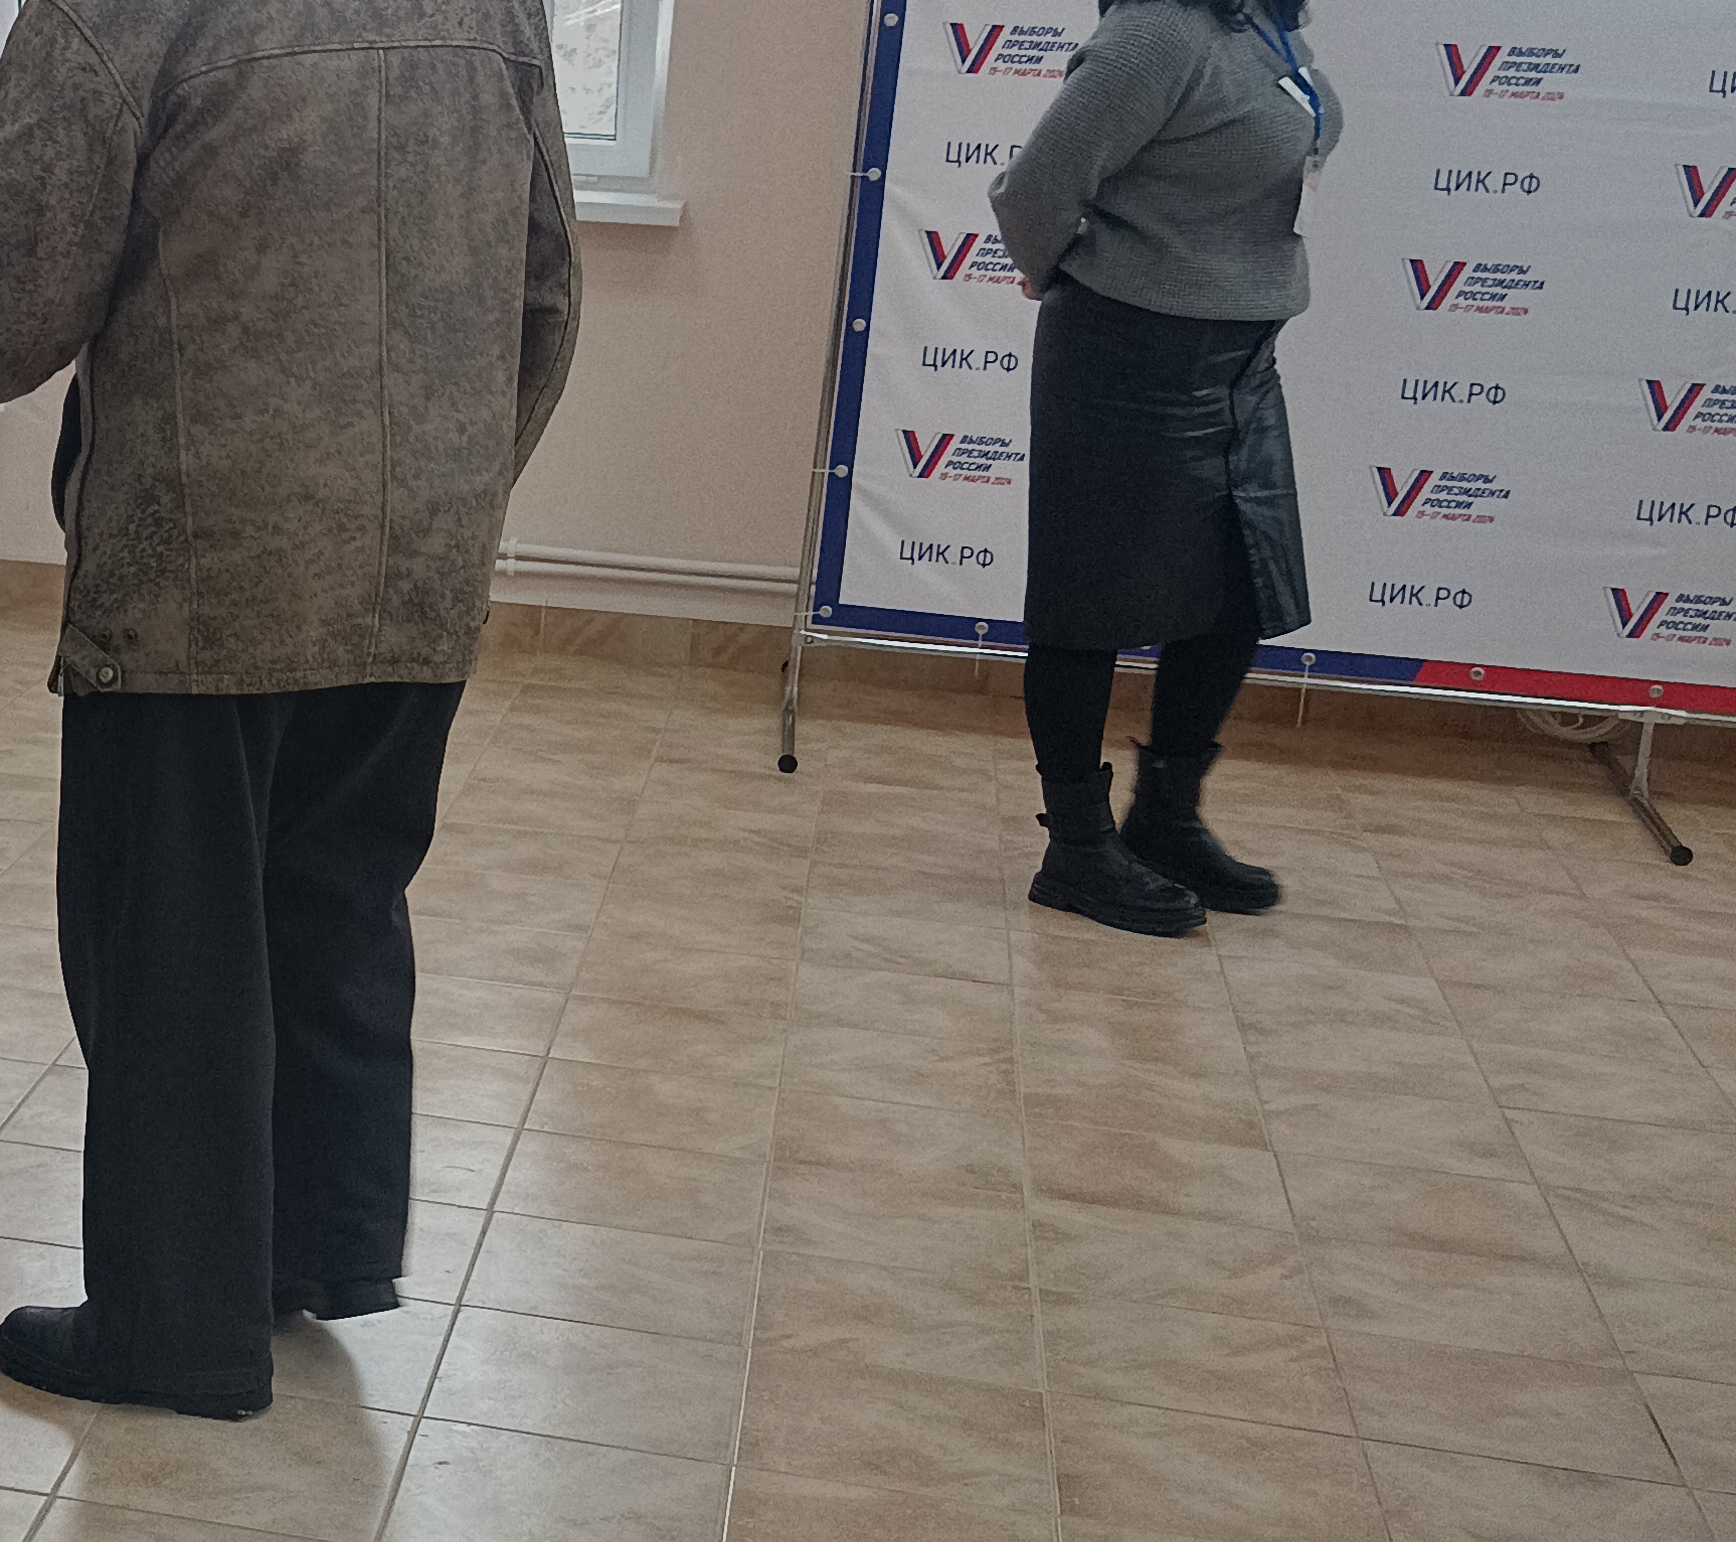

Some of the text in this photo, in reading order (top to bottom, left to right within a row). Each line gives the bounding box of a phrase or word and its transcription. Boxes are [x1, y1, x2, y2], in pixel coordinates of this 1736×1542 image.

[1010, 26, 1065, 37] ВЫБОРЫ
[994, 54, 1044, 64] РОССИИ
[1507, 47, 1566, 58] ВЫБОРЫ
[1497, 61, 1580, 74] ПРЕЗИДЕНТА
[1490, 75, 1543, 87] РОССИИ
[945, 141, 1023, 168] ЦИК.
[1434, 168, 1540, 196] ЦИК.РФ
[1472, 263, 1531, 275] ВЫБОРЫ
[1464, 277, 1545, 290] ПРЕЗИДЕНТА
[1455, 290, 1508, 302] РОССИИ
[921, 346, 1019, 373] ЦИК.РФ
[1401, 378, 1506, 405] ЦИК.РФ
[959, 435, 1012, 448] ВЫБОРЫ
[952, 448, 1026, 462] ПРЕЗИДЕНТА
[944, 460, 992, 473] РОССИИ
[1438, 471, 1497, 484] ВЫБОРЫ
[1430, 485, 1511, 499] ПРЕЗИДЕНТА
[1421, 498, 1474, 510] РОССИИ
[899, 539, 994, 569] ЦИК.РФ
[1369, 581, 1473, 609] ЦИК.РФ
[1675, 593, 1734, 606] ВЫБОРЫ
[1657, 620, 1710, 633] РОССИИ
